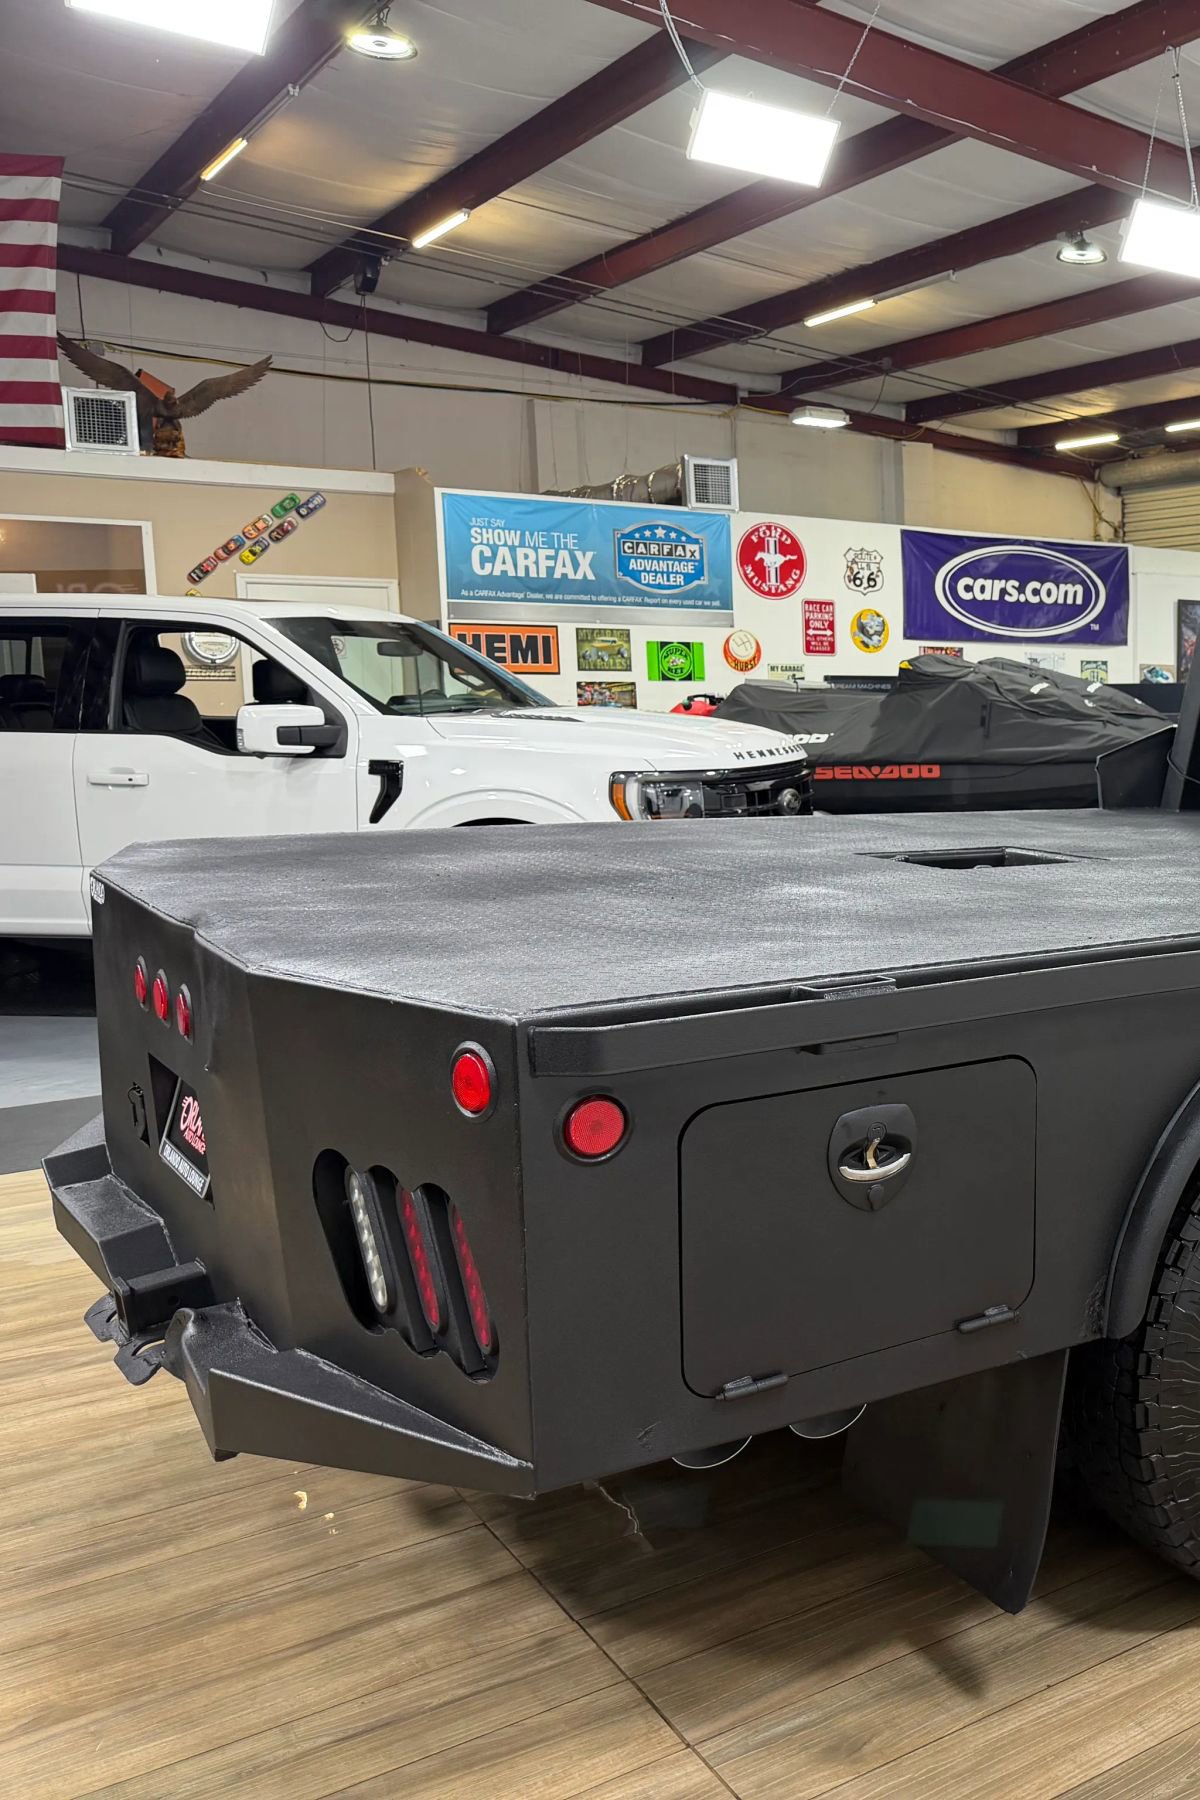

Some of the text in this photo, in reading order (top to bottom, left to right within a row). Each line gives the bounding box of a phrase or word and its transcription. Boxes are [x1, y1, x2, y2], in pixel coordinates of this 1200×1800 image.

[469, 517, 506, 528] JUST SAY
[470, 528, 579, 549] SHOW ME THE
[750, 525, 792, 546] FORD
[623, 540, 697, 559] CARFAX
[853, 552, 873, 562] ROUTE
[471, 545, 596, 581] CARFAX
[629, 559, 696, 573] ADVANTAGE
[641, 572, 685, 586] DEALER
[743, 564, 801, 594] MUSTANG
[853, 570, 878, 590] 66
[474, 589, 496, 598] CARFAX
[956, 576, 1084, 605] cars.com
[804, 604, 834, 613] RACE CAR
[805, 612, 834, 621] PARKING
[809, 620, 830, 629] ONLY
[1090, 623, 1100, 631] TM
[455, 633, 553, 665] HEMI
[734, 656, 758, 672] HURST
[780, 665, 804, 673] GARAGE
[163, 1144, 205, 1193] ORLANDO AUTO LOUNGE
